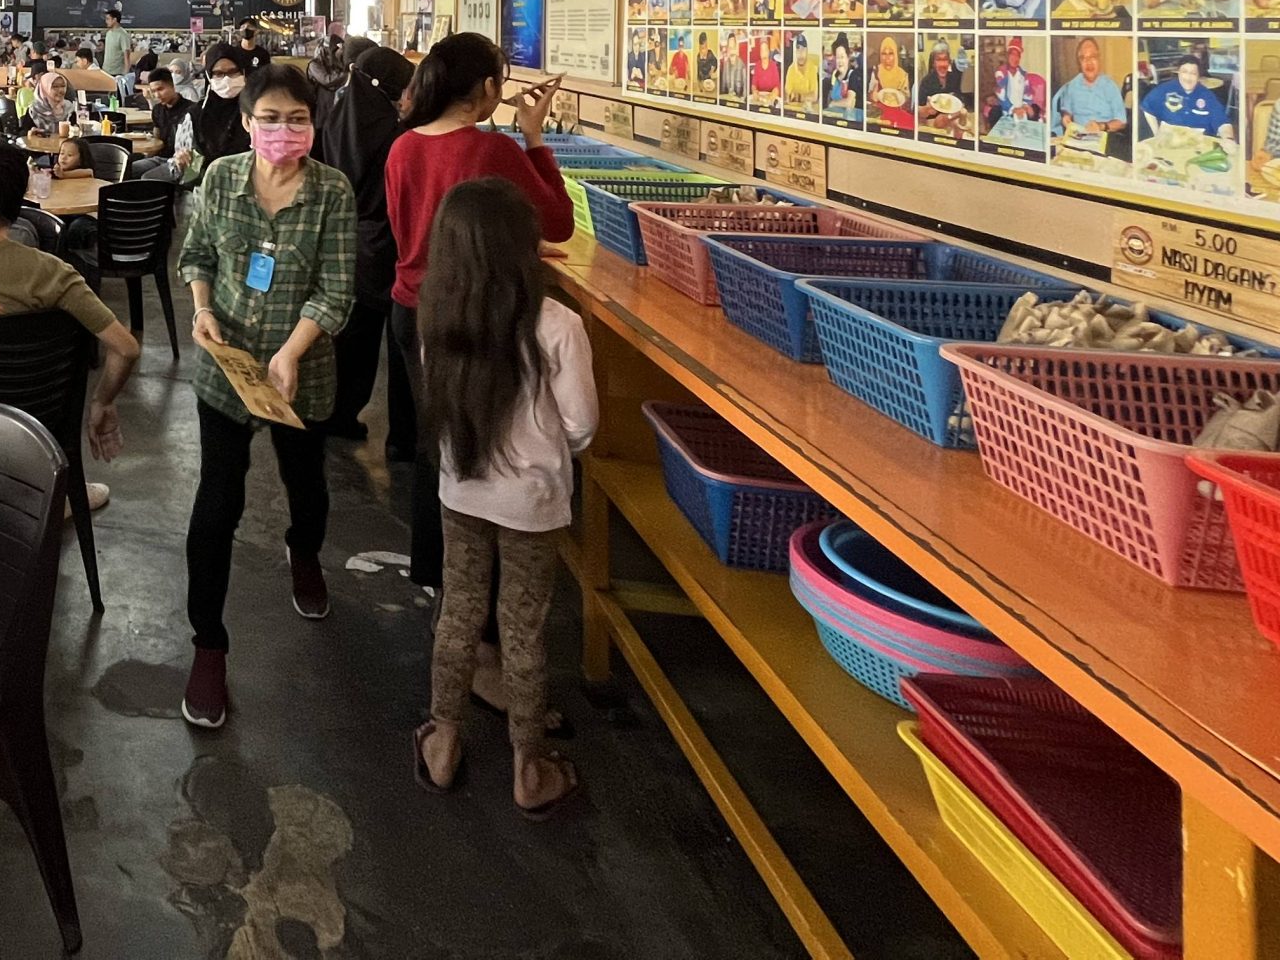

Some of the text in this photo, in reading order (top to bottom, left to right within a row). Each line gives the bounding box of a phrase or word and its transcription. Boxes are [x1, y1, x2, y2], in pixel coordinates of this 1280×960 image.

[1195, 229, 1237, 255] 5.00
[1161, 246, 1198, 273] NASI
[1184, 279, 1233, 313] AYAM
